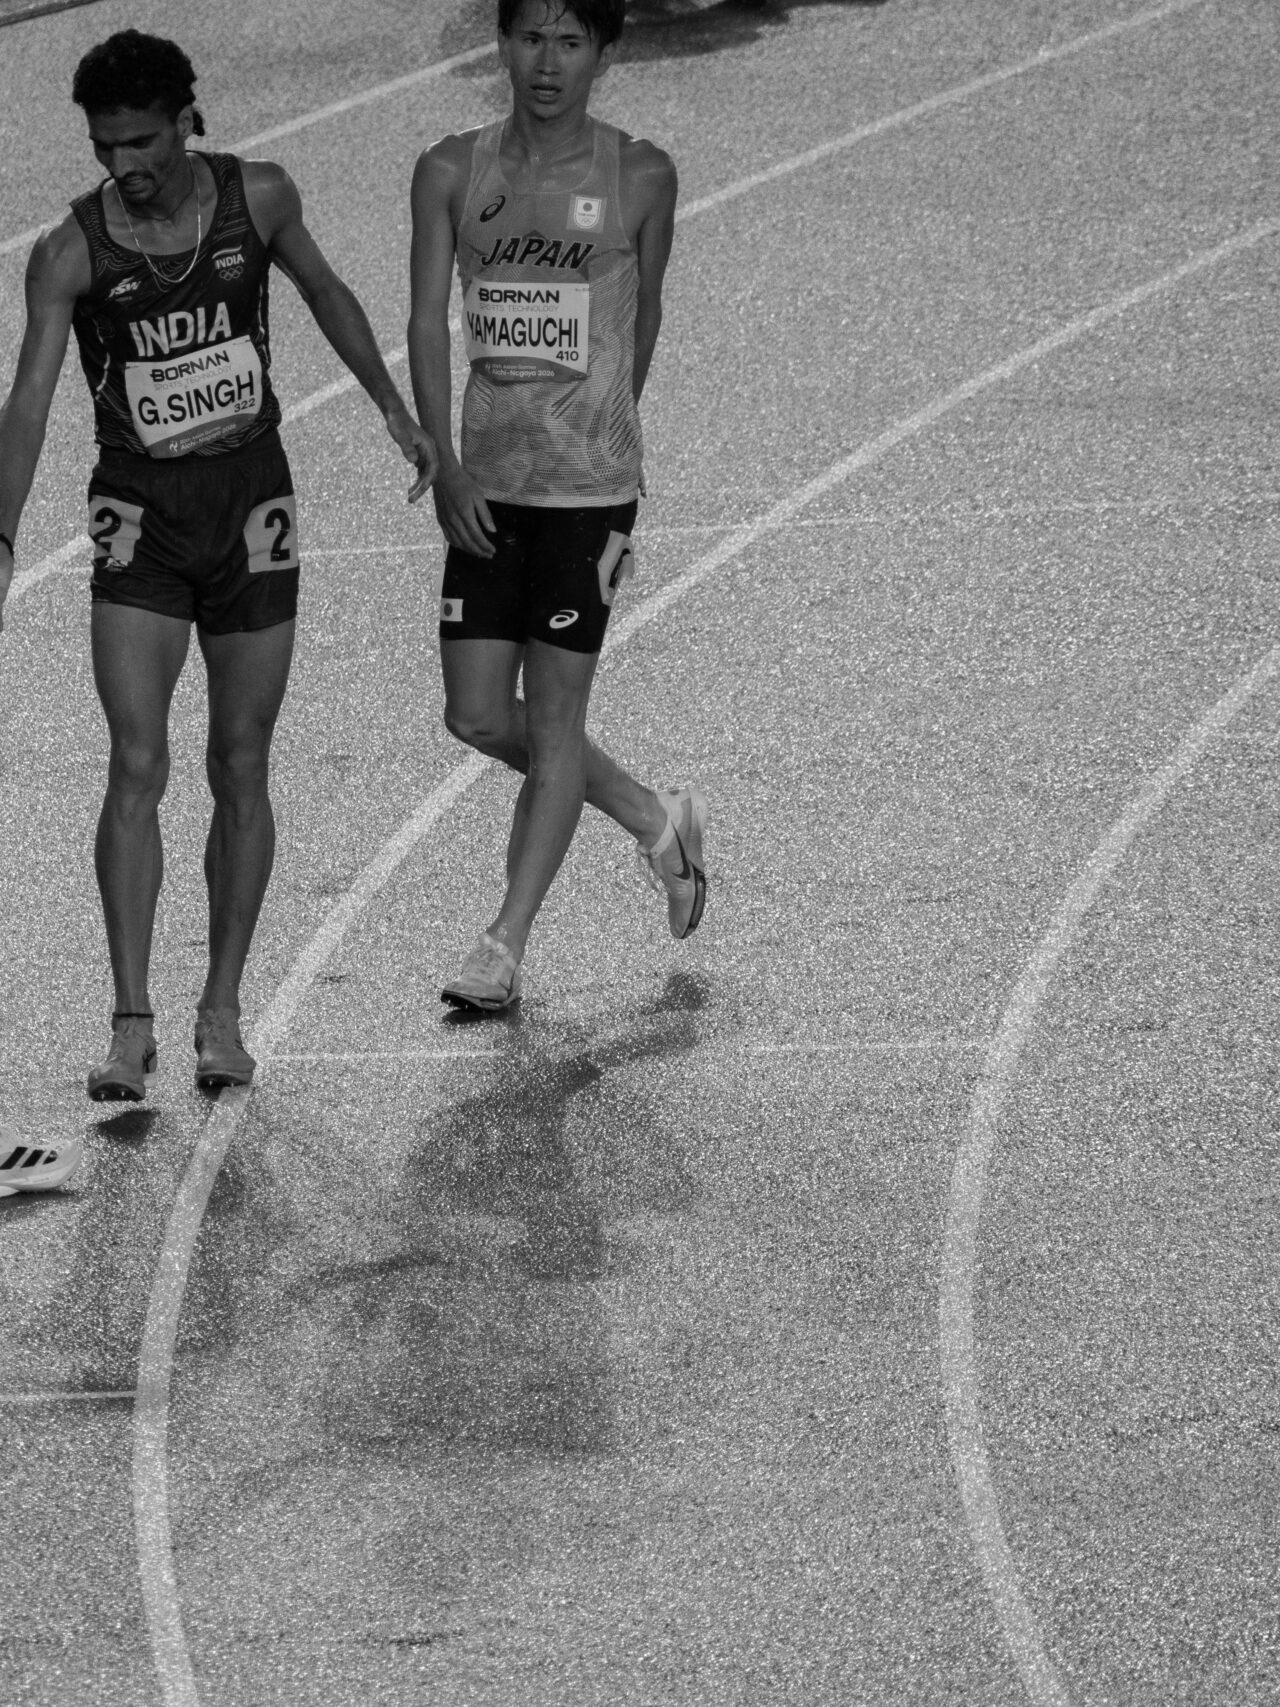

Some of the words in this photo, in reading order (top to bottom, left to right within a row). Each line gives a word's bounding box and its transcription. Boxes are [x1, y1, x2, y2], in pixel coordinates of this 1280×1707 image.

[215, 253, 245, 269] INDIA
[481, 237, 596, 269] JAPAN
[478, 287, 560, 303] BORNAN
[129, 302, 232, 357] INDIA
[467, 311, 578, 348] YAMAGUCHI
[150, 350, 230, 382] BORNAN
[556, 350, 579, 361] 410
[537, 369, 555, 377] 2026
[138, 370, 254, 426] G.SINGH
[234, 398, 255, 413] 322
[92, 507, 121, 553] 2
[264, 508, 291, 562] 2
